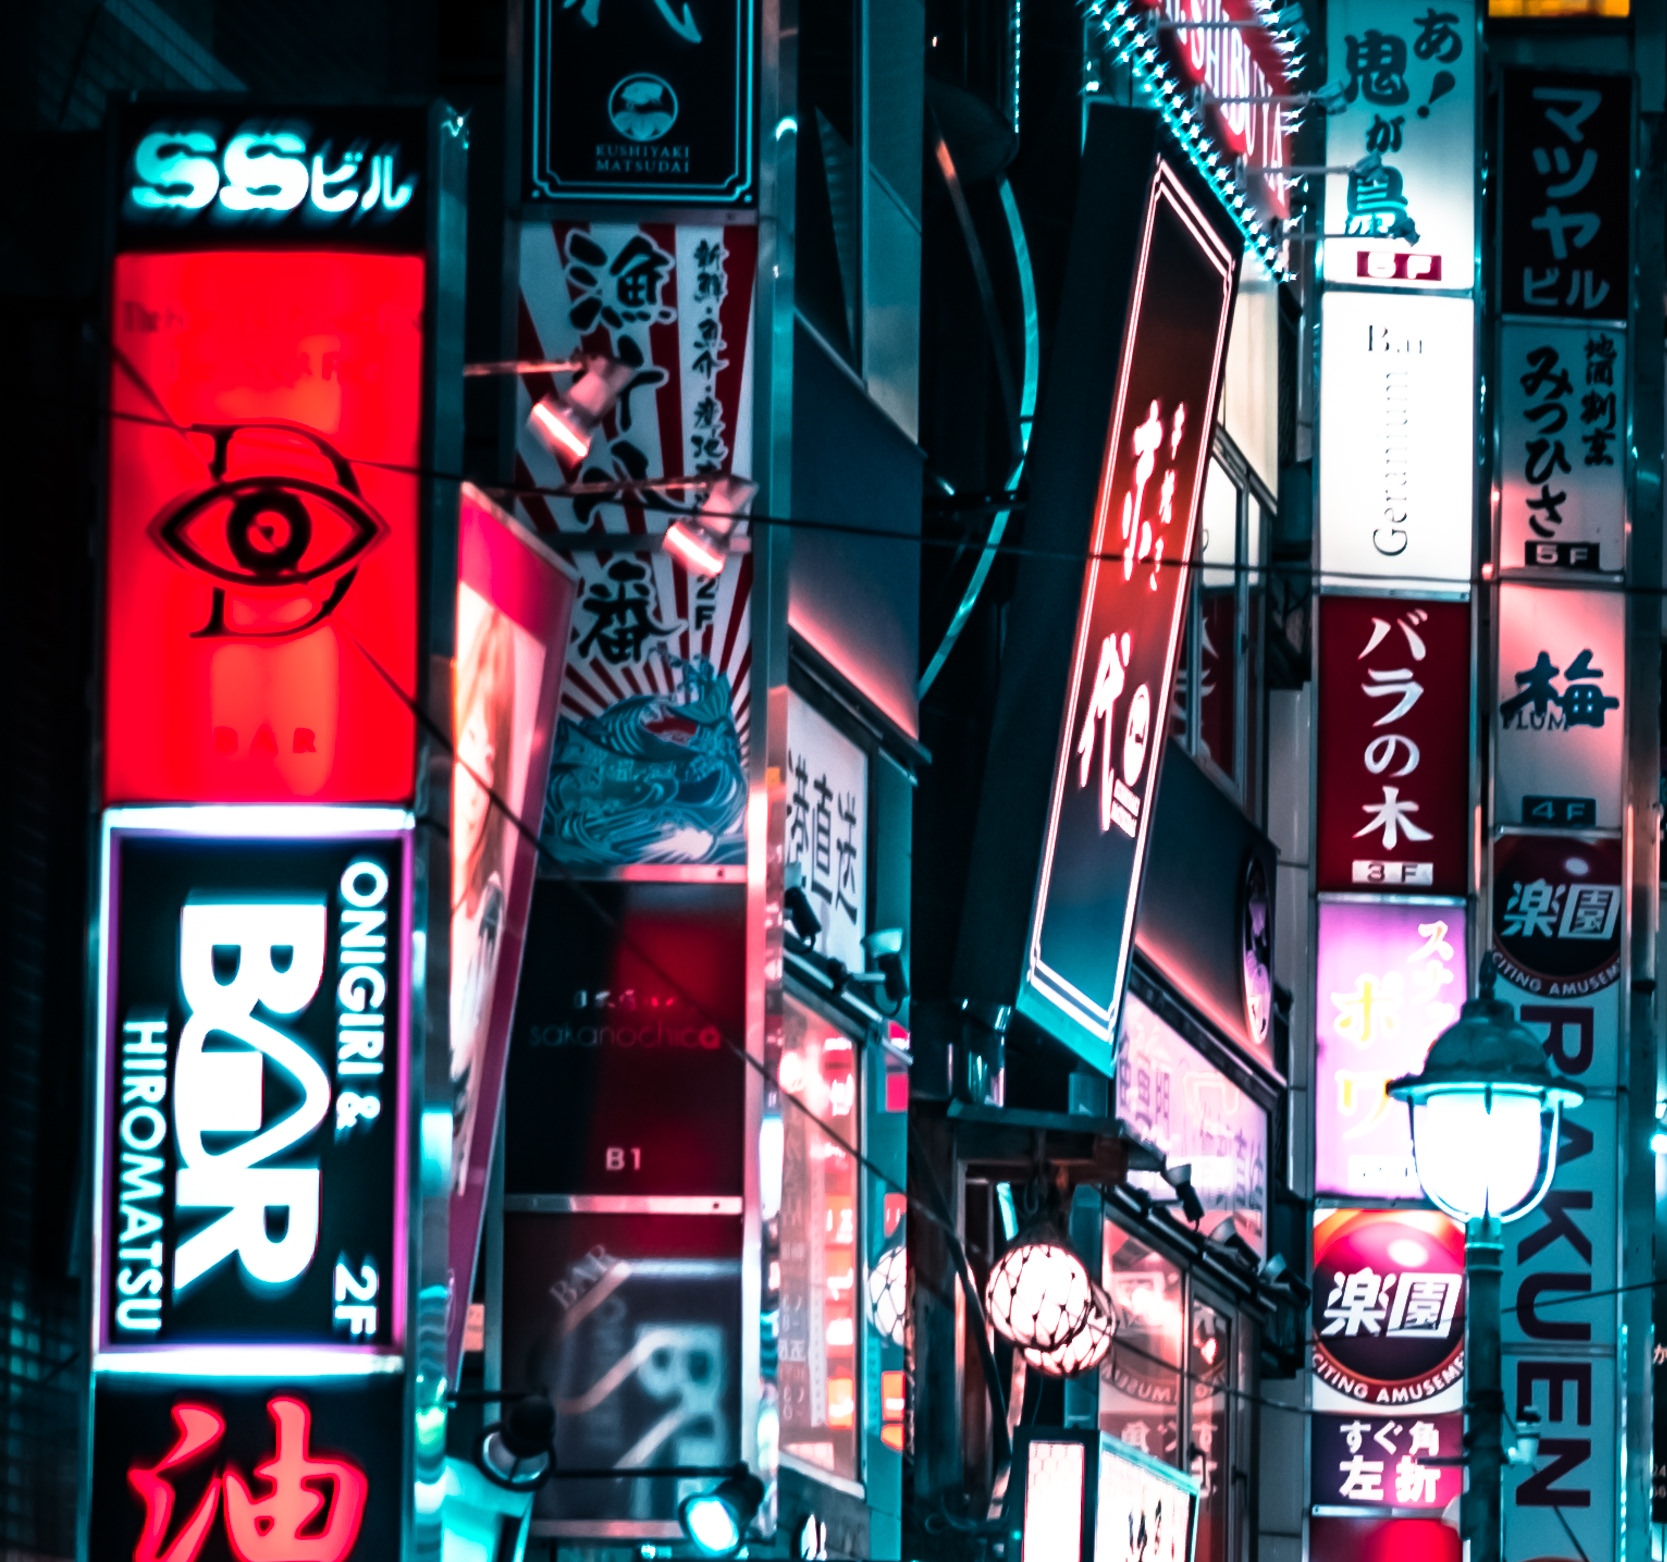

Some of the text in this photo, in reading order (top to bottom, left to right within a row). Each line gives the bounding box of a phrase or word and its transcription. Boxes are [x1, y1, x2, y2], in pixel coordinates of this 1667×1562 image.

[131, 131, 413, 212] SSビル
[596, 145, 690, 159] KUSHIYAKI
[596, 160, 690, 174] MATSUDAI
[1522, 265, 1611, 310] ビル
[1520, 346, 1574, 538] みつひさ
[1536, 544, 1589, 565] 5F
[1499, 648, 1620, 729] 梅
[213, 726, 318, 754] BAR
[1352, 608, 1434, 851] バラの木
[1530, 799, 1587, 822] 4F
[1366, 862, 1420, 884] 3F
[1501, 878, 1622, 940] 楽園
[335, 860, 389, 1133] ONIGIRI &
[171, 903, 331, 1292] BAR
[116, 1019, 168, 1333] HIROMATSU
[605, 1147, 642, 1171] B1
[1516, 1003, 1595, 1508] RAKUEN
[331, 1257, 379, 1337] 2F
[1320, 1266, 1464, 1339] 楽園
[1339, 1419, 1441, 1457] すぐ角
[1339, 1454, 1441, 1503] 左折
